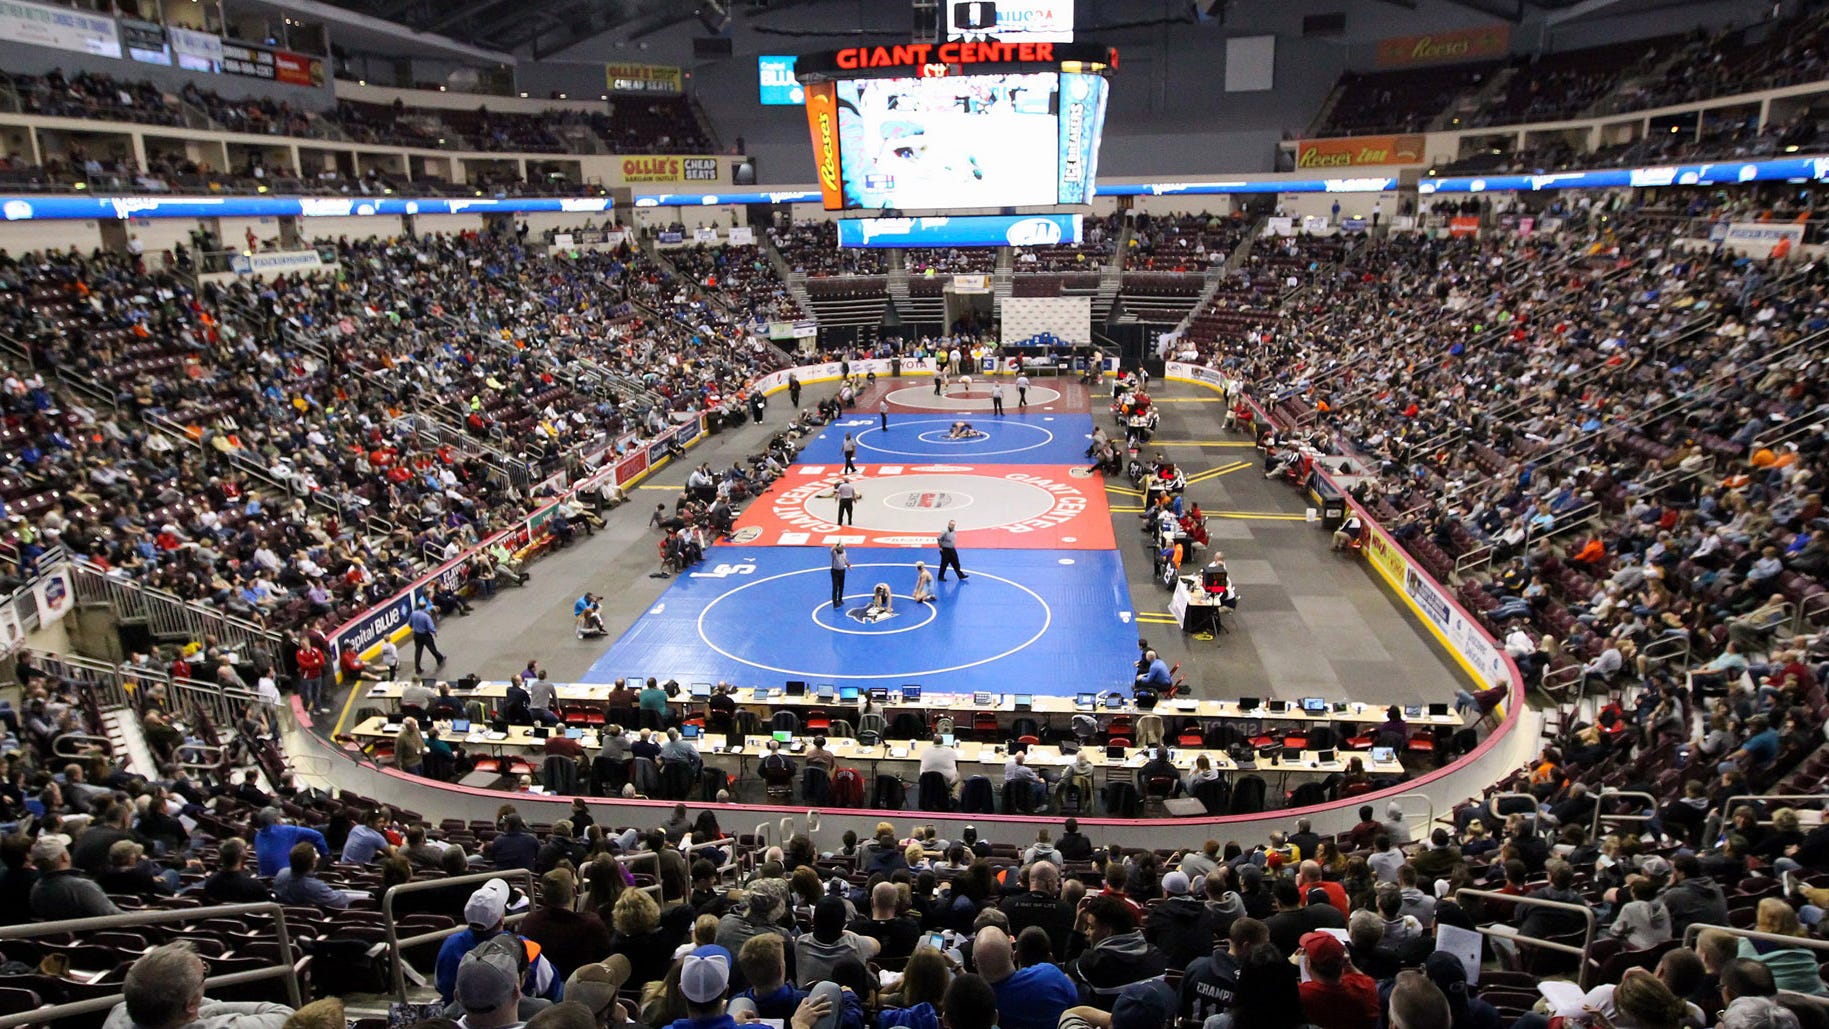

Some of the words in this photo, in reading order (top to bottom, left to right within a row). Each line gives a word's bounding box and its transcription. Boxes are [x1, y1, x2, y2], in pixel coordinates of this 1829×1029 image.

[836, 43, 933, 69] GIANT
[938, 41, 1054, 64] CENTER
[819, 111, 838, 191] Reese's
[1300, 147, 1351, 168] Reese's
[623, 157, 678, 175] OLLIE'S
[684, 159, 716, 170] CHEAP
[685, 169, 716, 179] SEATS
[1005, 473, 1082, 495] GIANT
[772, 506, 842, 533] GIANT
[1000, 496, 1087, 533] CENTER
